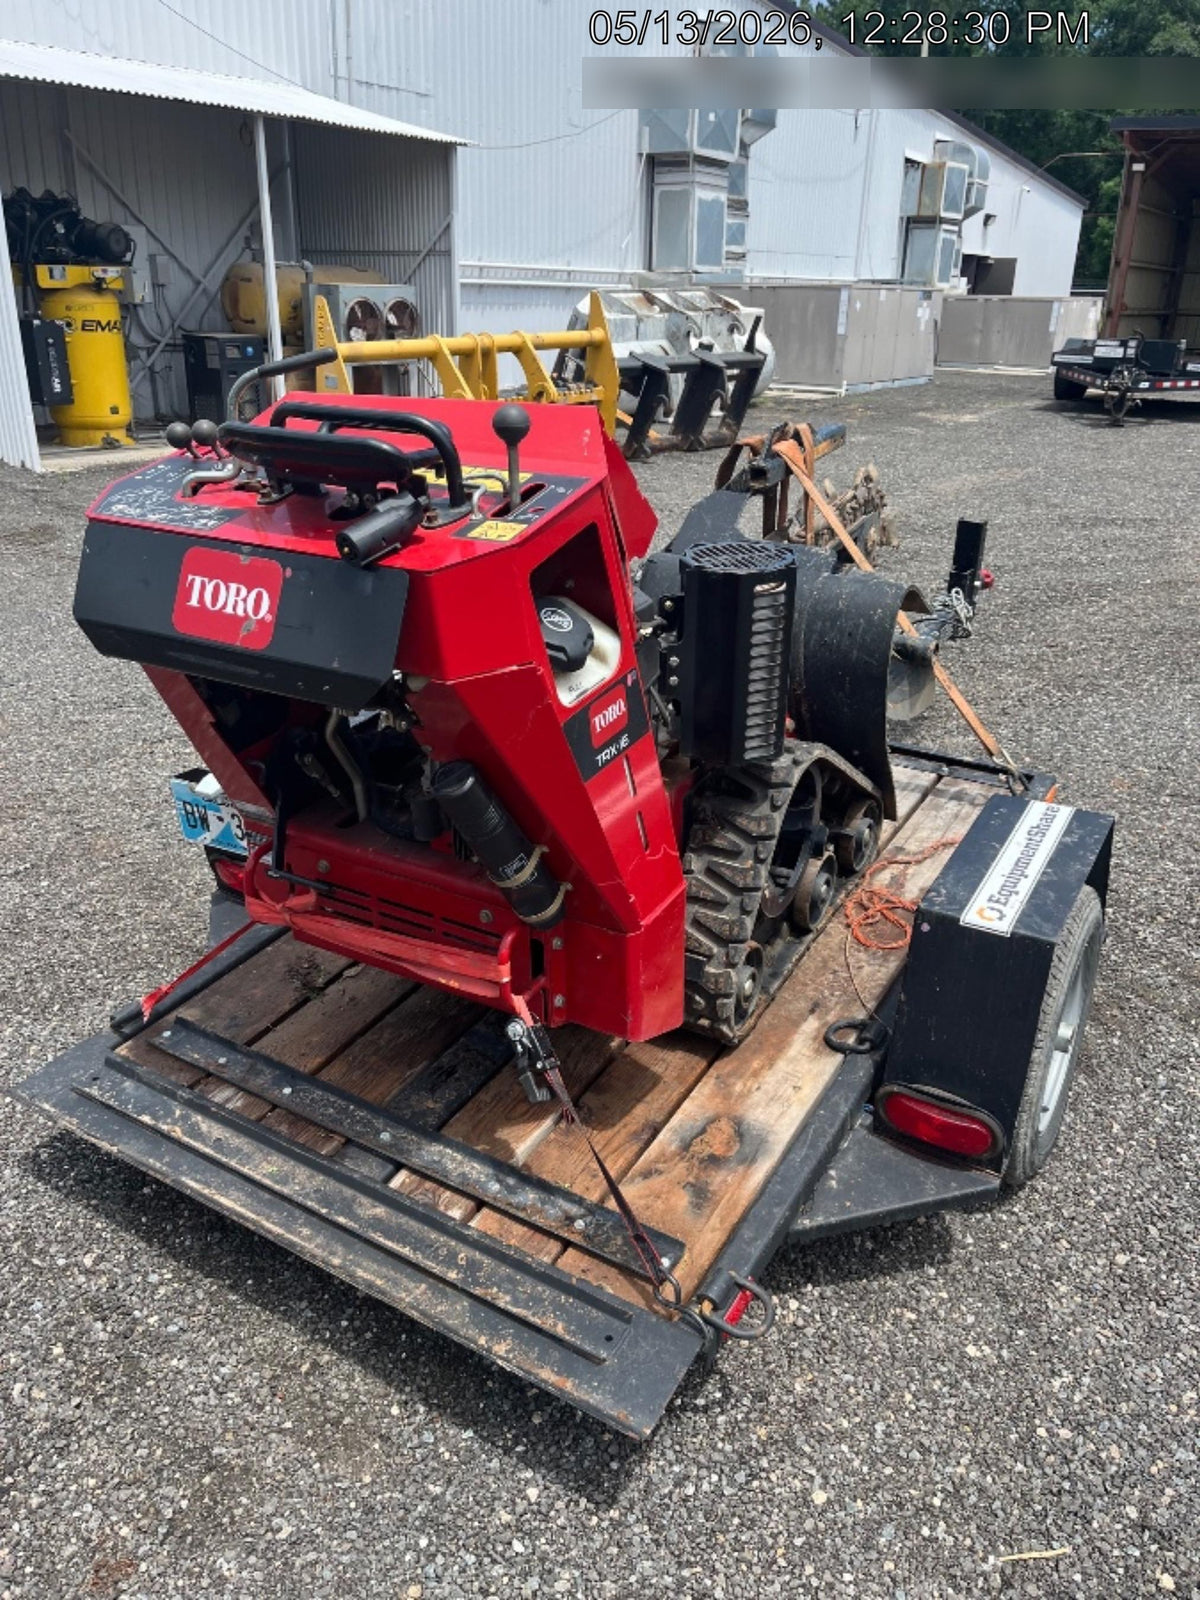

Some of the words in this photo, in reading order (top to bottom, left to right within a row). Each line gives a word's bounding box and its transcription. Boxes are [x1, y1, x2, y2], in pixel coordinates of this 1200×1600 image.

[185, 573, 272, 621] TORO
[593, 698, 626, 733] TORO
[985, 805, 1062, 908] EquipmentShare
